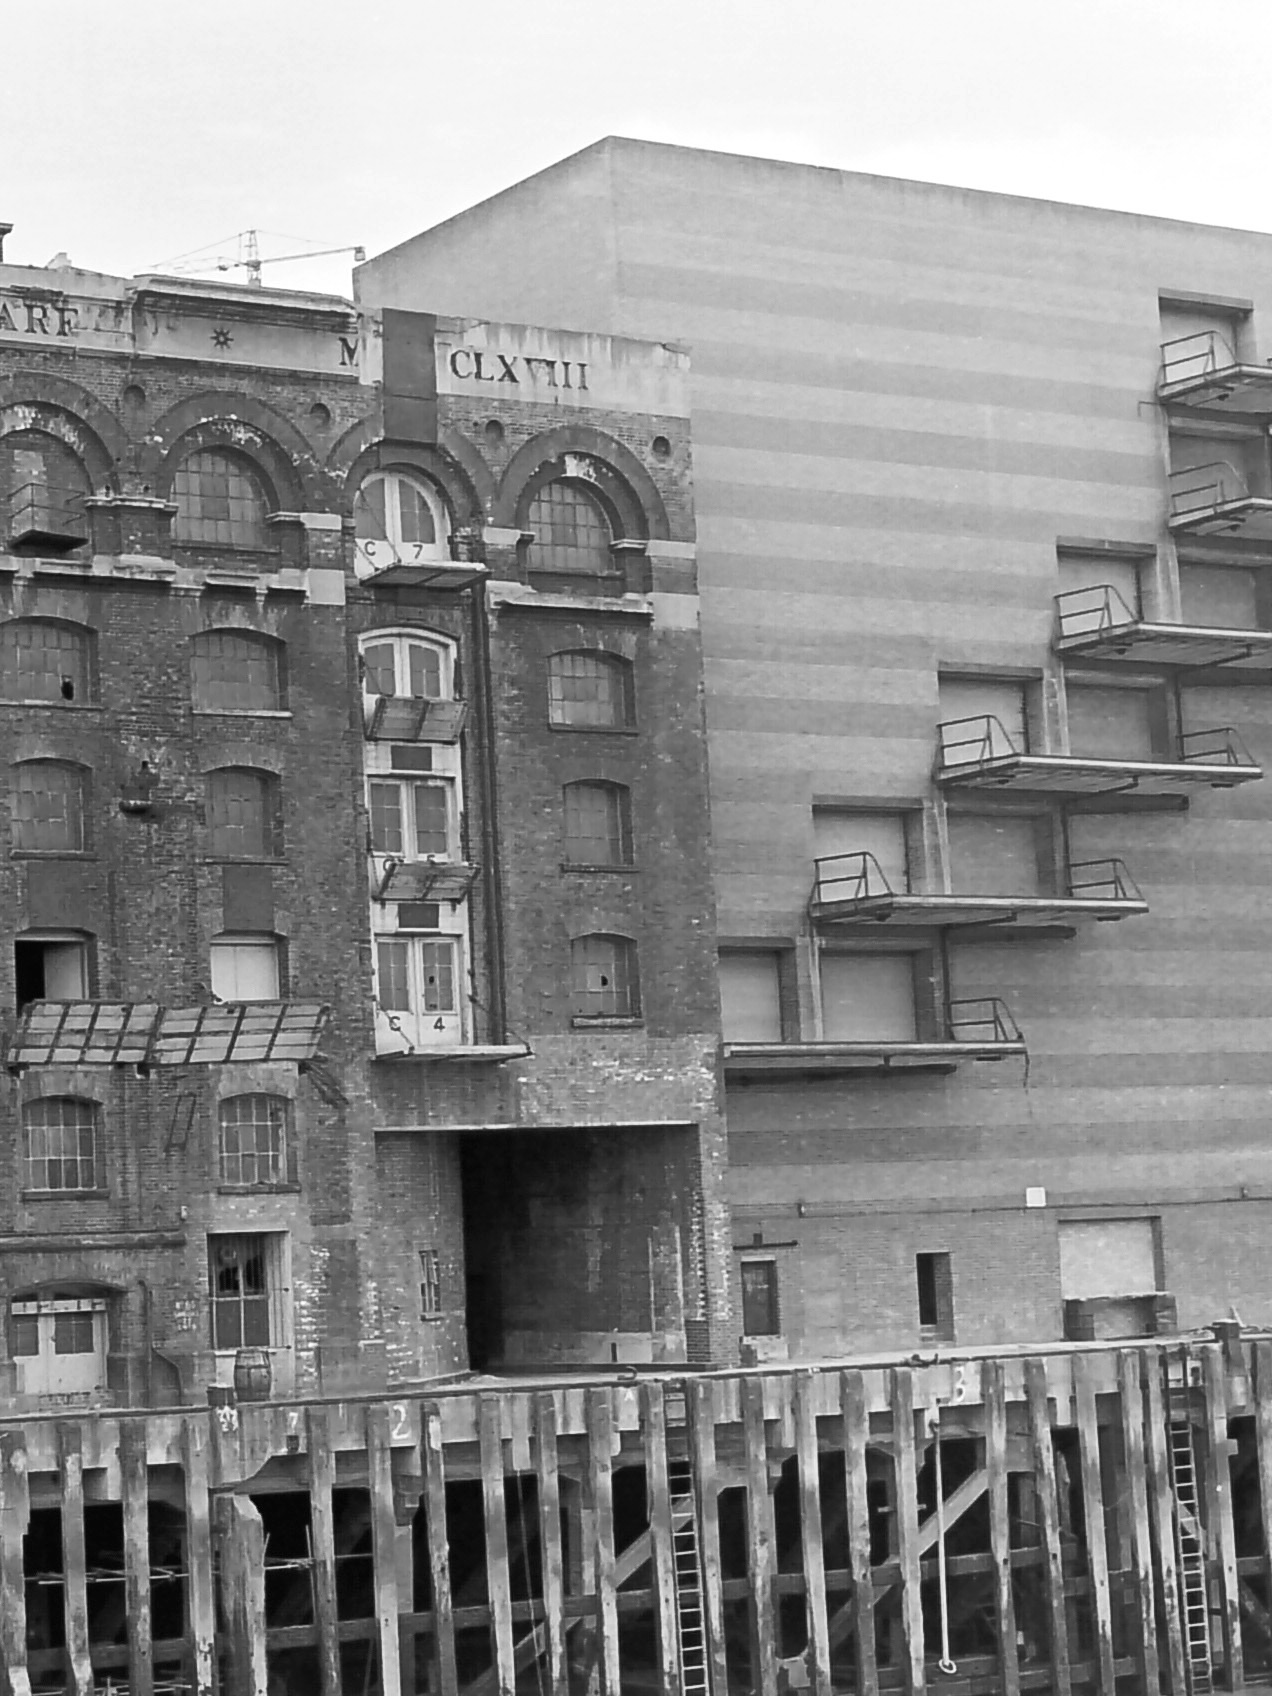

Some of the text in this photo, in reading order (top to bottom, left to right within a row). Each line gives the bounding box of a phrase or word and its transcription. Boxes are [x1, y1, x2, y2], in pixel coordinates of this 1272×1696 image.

[364, 540, 424, 560] C 7
[388, 1015, 446, 1033] C 4
[288, 1411, 299, 1432] 7
[392, 1404, 410, 1440] 2
